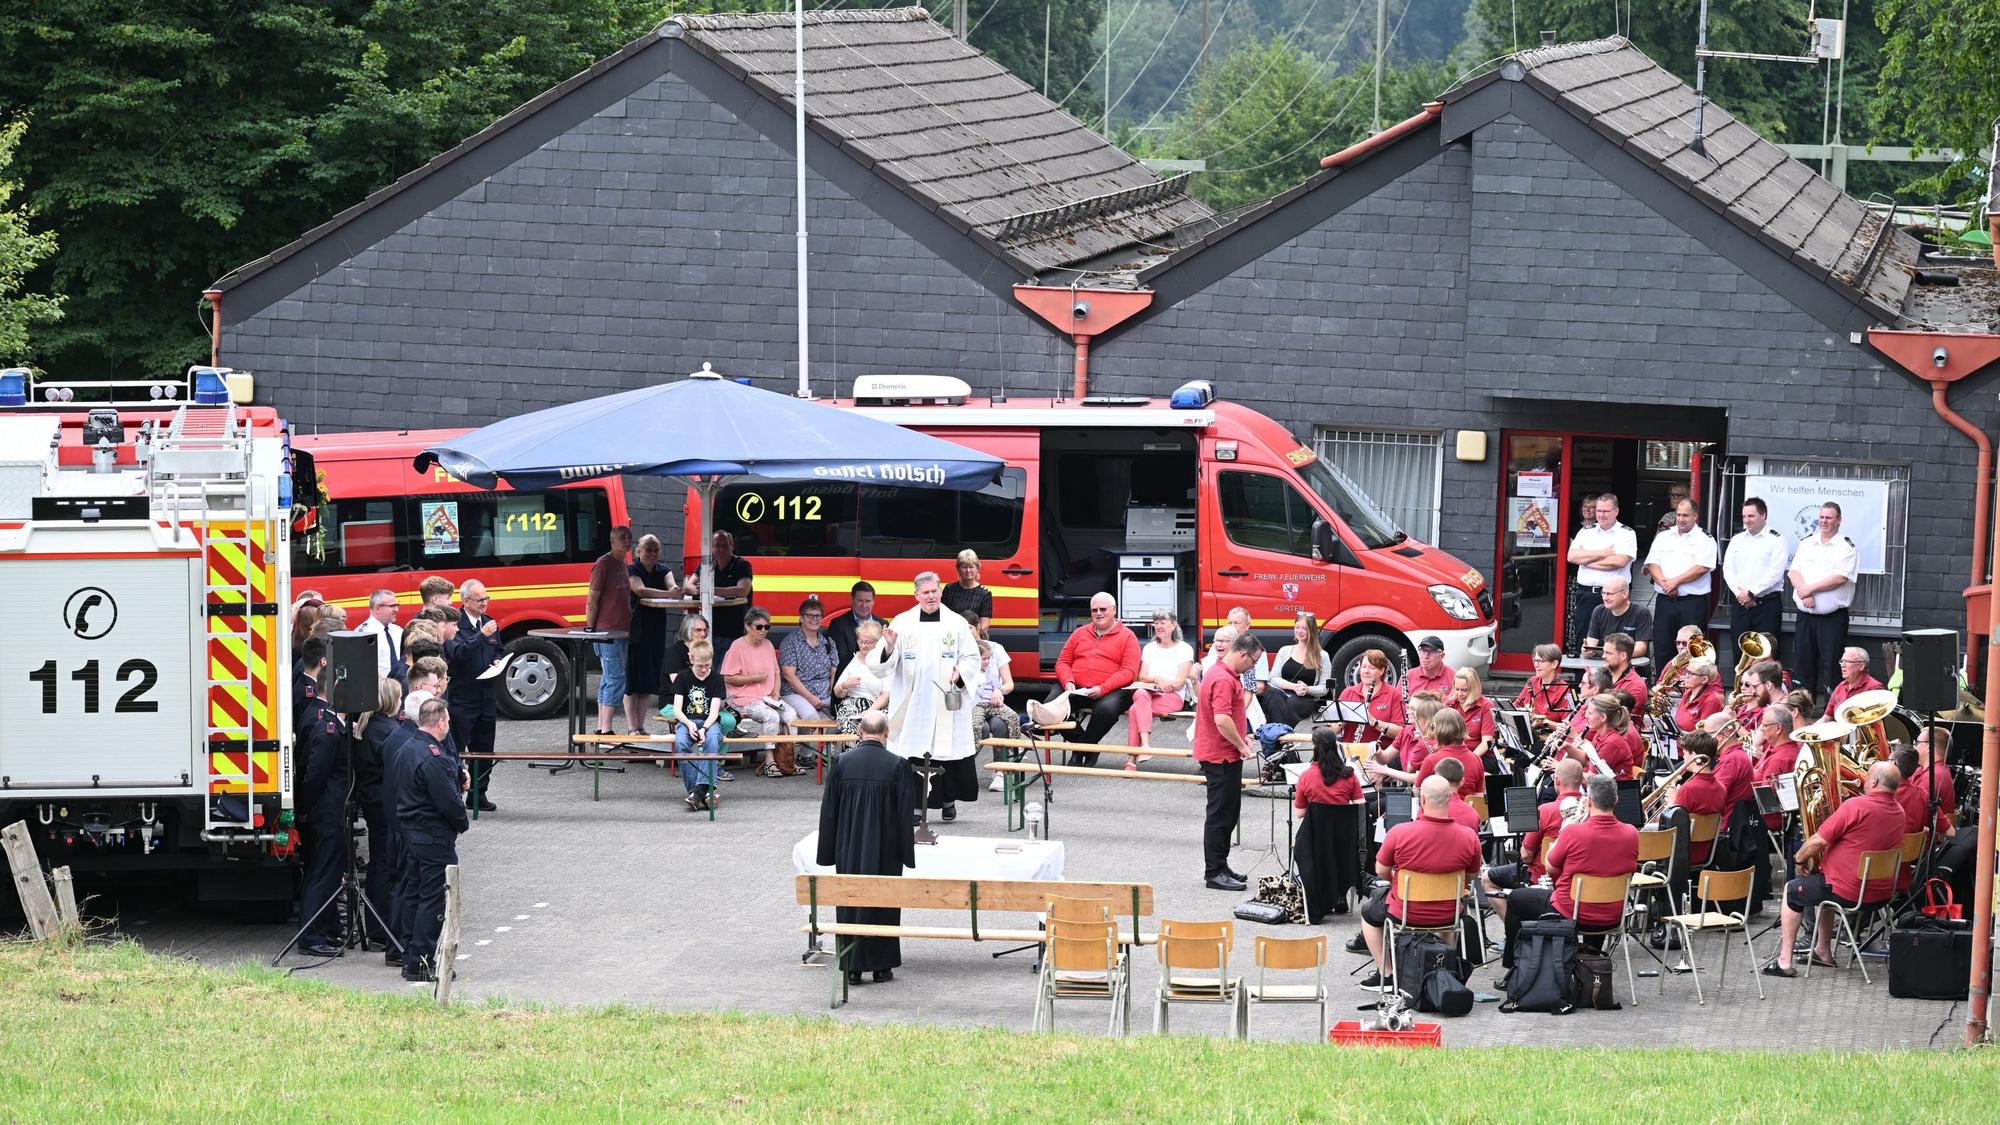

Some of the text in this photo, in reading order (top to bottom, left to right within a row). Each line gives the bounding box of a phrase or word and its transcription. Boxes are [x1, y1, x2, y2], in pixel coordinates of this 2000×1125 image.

[880, 463, 946, 486] Kölsch
[1770, 485, 1864, 497] Wir helfen Menschen
[773, 495, 822, 520] 112
[517, 512, 557, 531] 112
[1280, 573, 1326, 582] FEUERWEHR
[29, 658, 158, 714] 112
